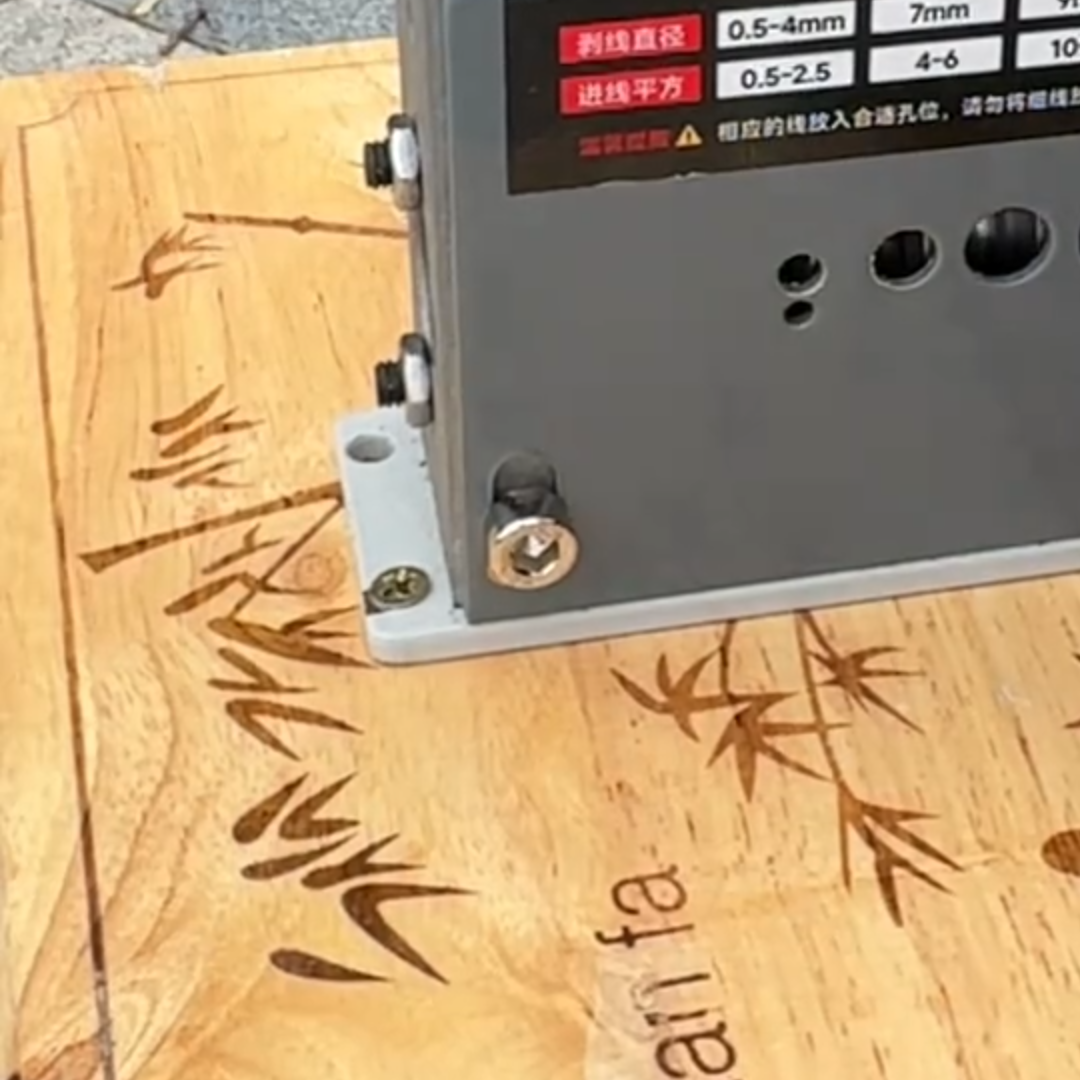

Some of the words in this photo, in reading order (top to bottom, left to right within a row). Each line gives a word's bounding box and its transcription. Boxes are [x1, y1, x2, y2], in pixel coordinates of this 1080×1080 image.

[579, 25, 684, 57] 剥线直径
[729, 16, 844, 40] 0.5-4mm
[911, 4, 968, 22] 7mm
[579, 77, 682, 106] 进线平方
[742, 63, 830, 88] 0.5-2.5
[916, 51, 958, 70] 4-6
[596, 864, 694, 949] fa
[632, 973, 738, 1079] an
